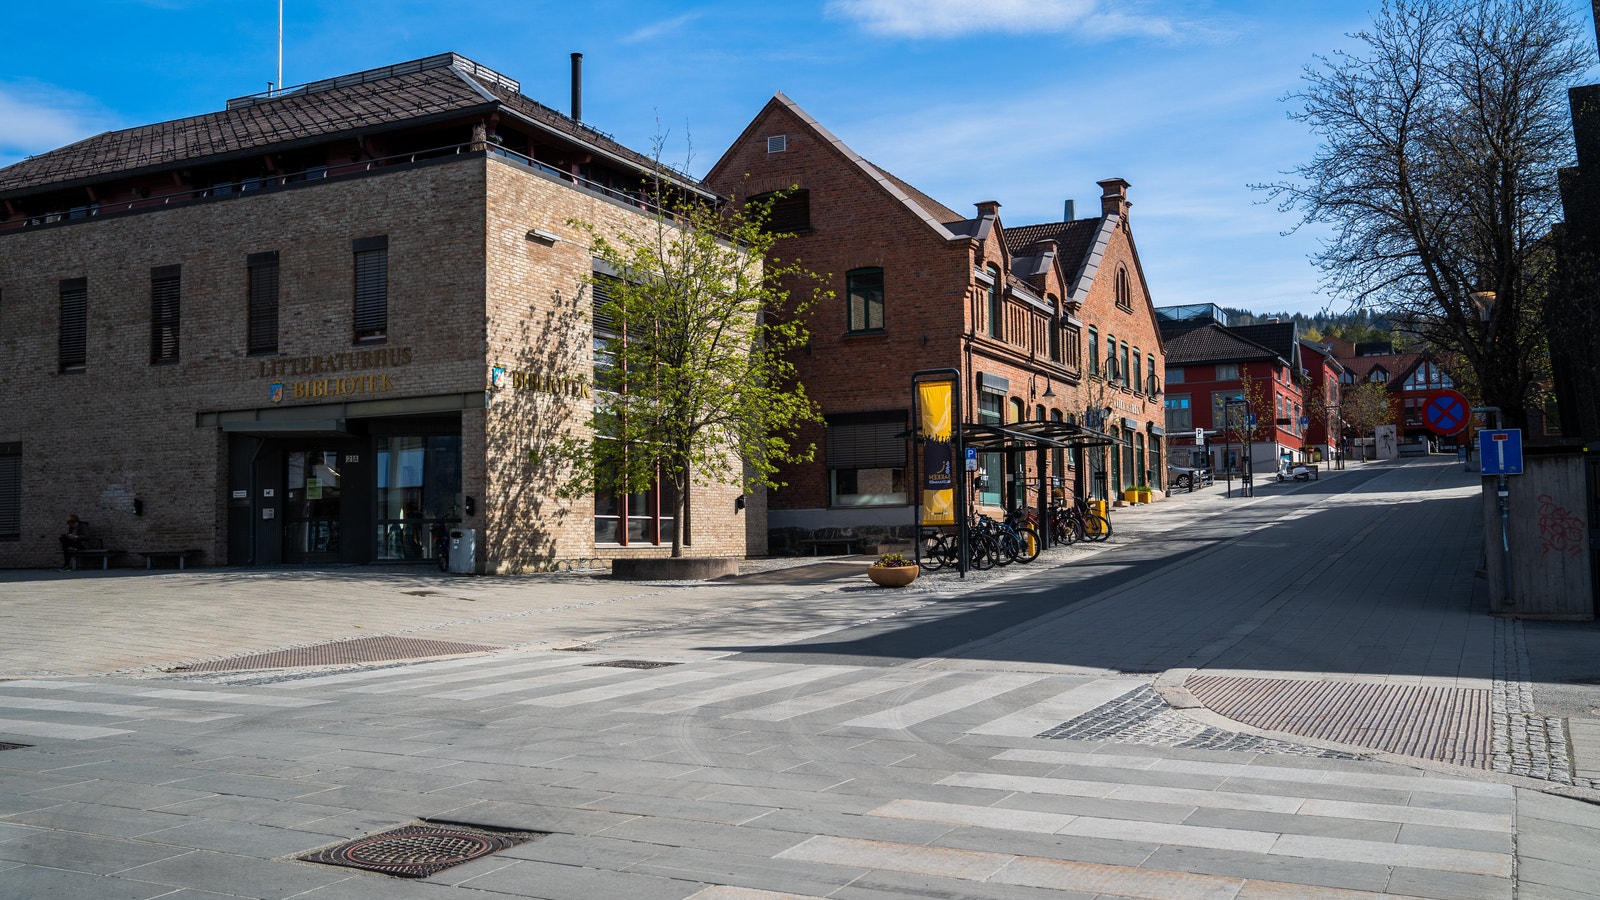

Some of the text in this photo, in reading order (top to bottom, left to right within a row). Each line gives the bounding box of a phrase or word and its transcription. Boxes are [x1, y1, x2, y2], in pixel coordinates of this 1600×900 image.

[258, 347, 412, 378] LITTERATURHUS
[293, 373, 395, 399] BIBLIOTEK
[512, 370, 591, 399] BIBLIOTEK
[1197, 429, 1202, 438] P
[967, 449, 974, 458] P
